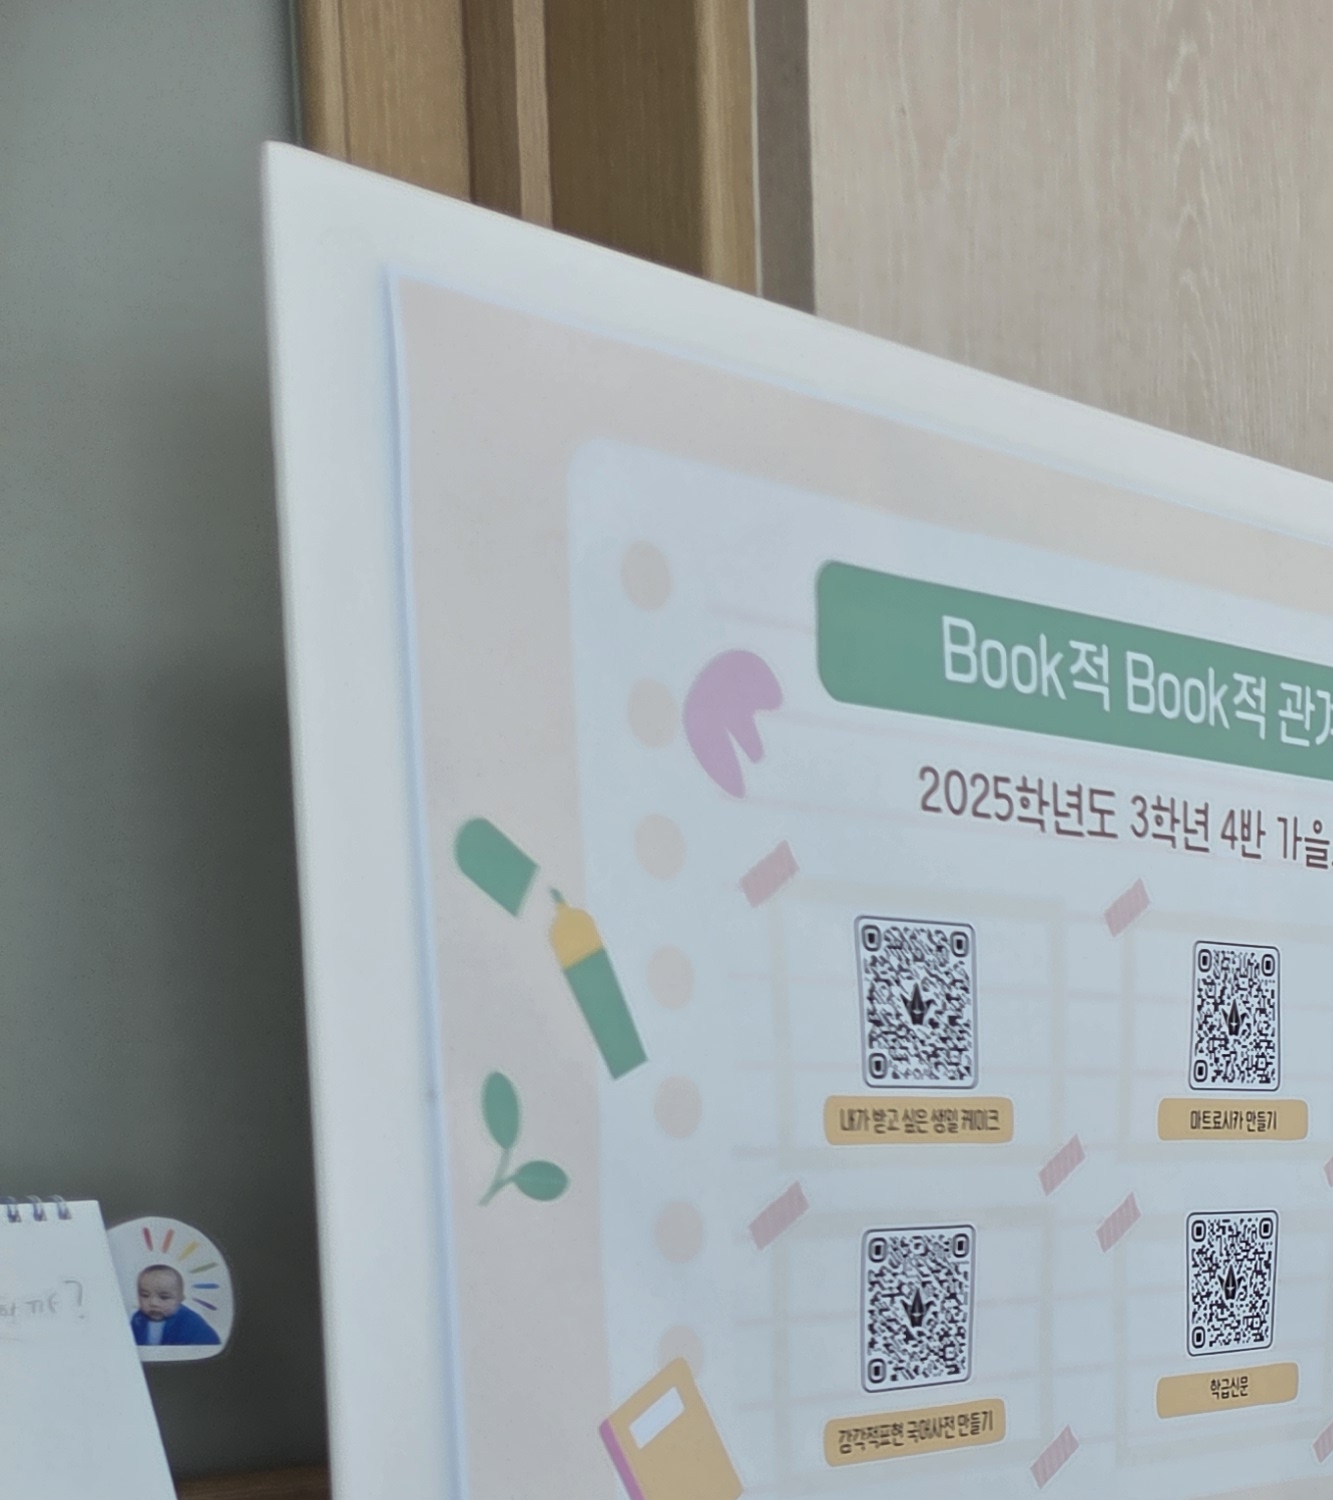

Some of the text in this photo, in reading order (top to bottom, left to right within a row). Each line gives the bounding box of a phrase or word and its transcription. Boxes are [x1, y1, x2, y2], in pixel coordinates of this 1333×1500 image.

[942, 615, 1111, 711] Book적
[1126, 651, 1266, 740] Book적
[918, 766, 1118, 840] 2025학년도
[1130, 795, 1210, 854] 3학년
[1220, 808, 1266, 860] 4반
[840, 1109, 1000, 1134] 내가 받고 싶은 생일 케이크
[1190, 1110, 1277, 1132] 마트료시카 만들기
[1210, 1376, 1249, 1400] 학급신문
[839, 1410, 993, 1454] 감각적표현 국어사전 만들기
